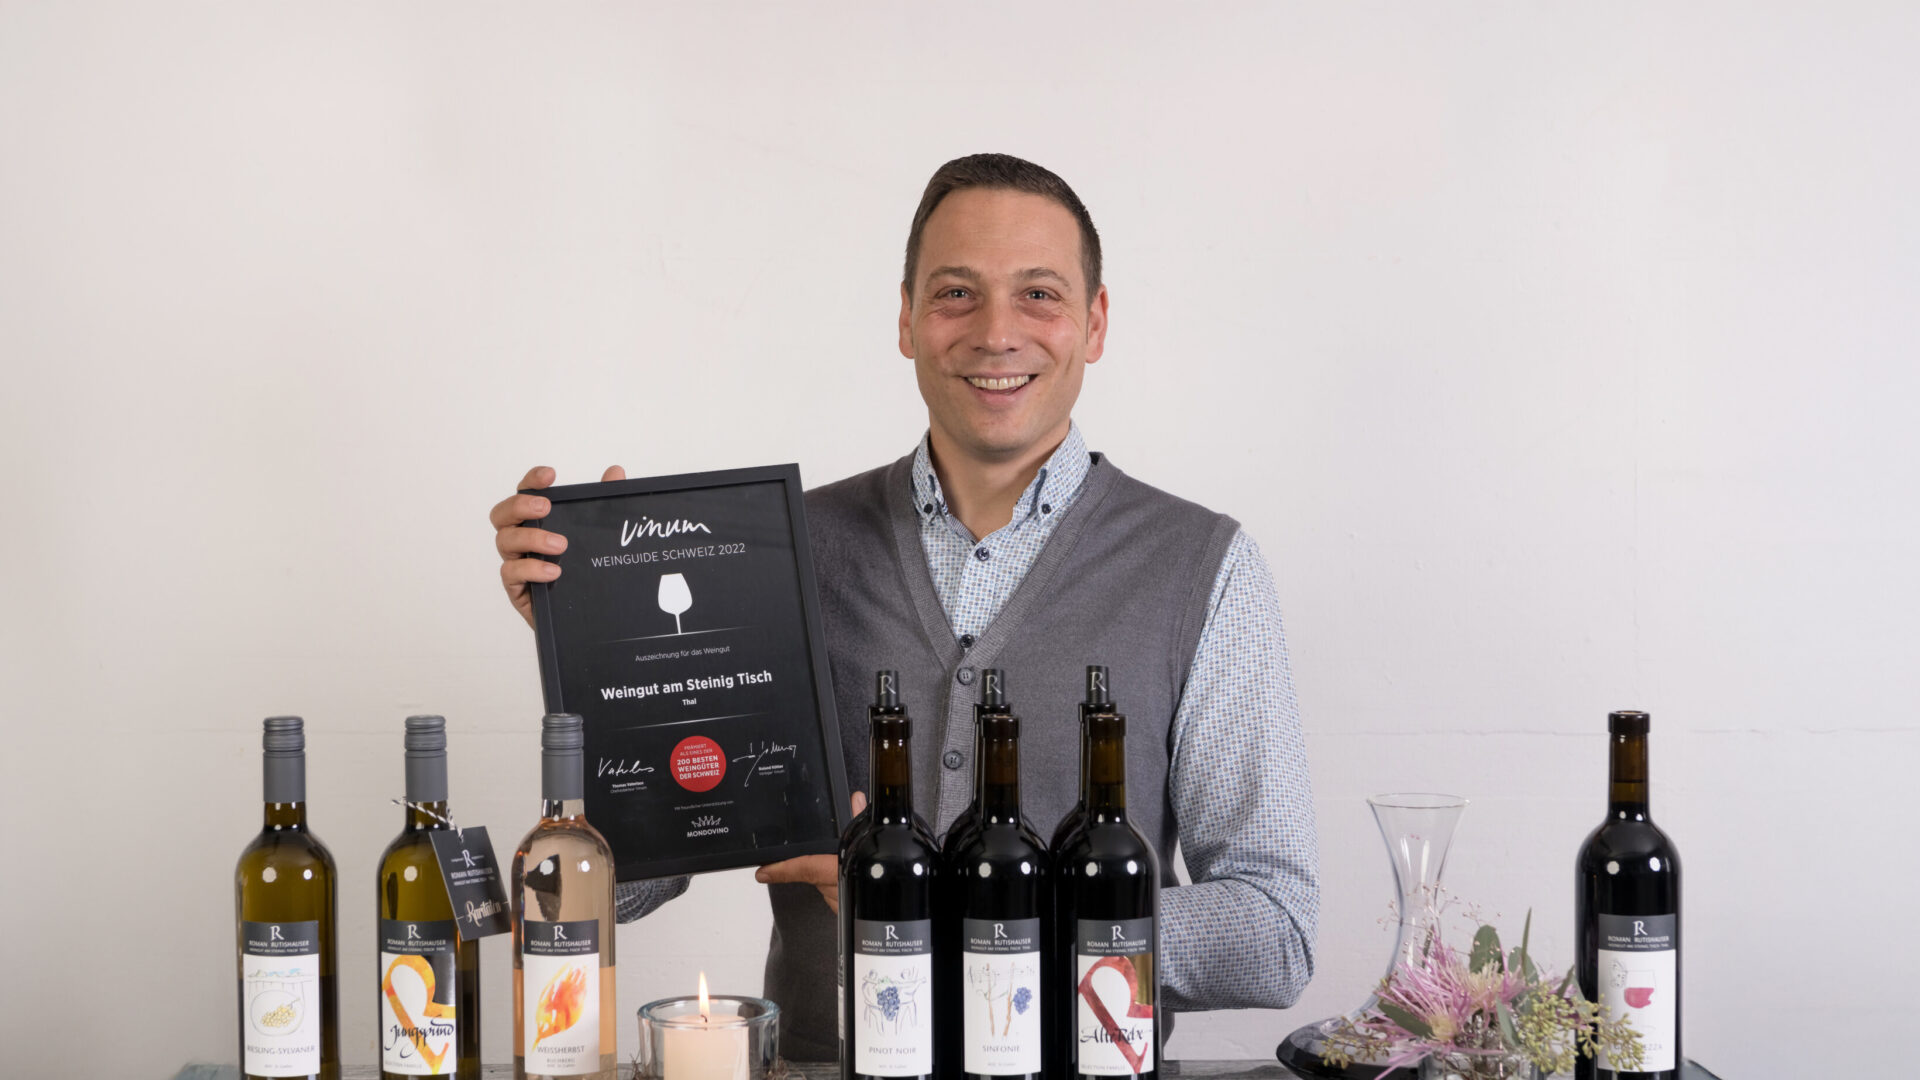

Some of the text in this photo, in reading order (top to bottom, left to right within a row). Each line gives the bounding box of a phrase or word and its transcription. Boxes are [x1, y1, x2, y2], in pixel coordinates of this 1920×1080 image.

[591, 542, 746, 569] WEINGUIDE SCHWEIZ 2022
[635, 646, 730, 662] Auszeichnung für das Weingut
[600, 669, 773, 701] Weingut am Steinig Tisch
[879, 675, 897, 695] R
[985, 675, 1002, 695] R
[1089, 671, 1107, 692] R
[682, 698, 697, 706] Thal
[677, 755, 718, 766] 200 BESTEN
[678, 762, 720, 773] WEINGÜTER
[693, 769, 720, 779] SCHWEIZ
[687, 826, 730, 838] MONDOVINO
[462, 849, 476, 868] R
[269, 925, 285, 941] R
[407, 924, 422, 940] R
[553, 925, 568, 941] R
[885, 924, 900, 940] R
[993, 923, 1008, 938] R
[1111, 925, 1126, 940] R
[1632, 920, 1648, 936] R
[249, 940, 310, 948] ROMAN RUTISHAUSER
[862, 939, 883, 947] ROMAN
[970, 937, 1032, 945] ROMAN RUTISHAUSER
[1086, 939, 1147, 948] ROMAN RUTISHAUSER
[1607, 935, 1631, 943] ROMAN
[538, 1045, 585, 1054] WEISSHERBST
[869, 1046, 917, 1055] PINOT NOIR
[982, 1044, 1020, 1053] SINFONIE
